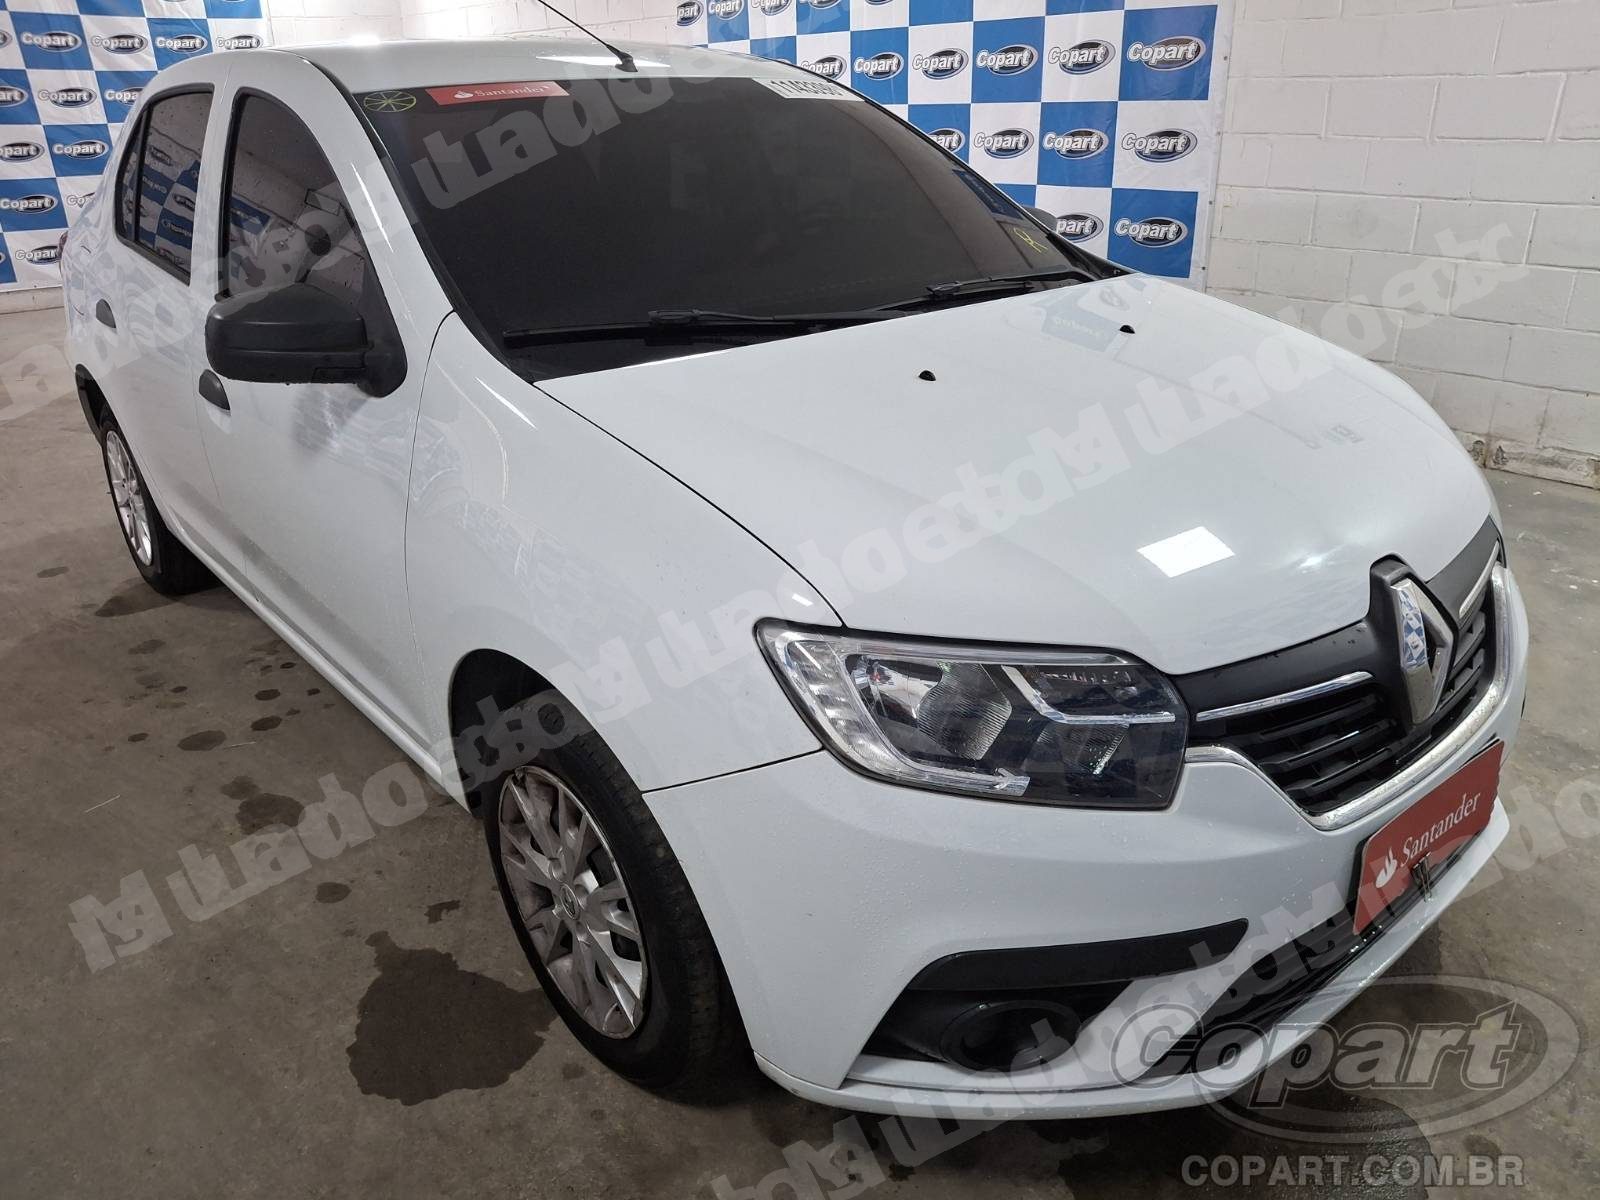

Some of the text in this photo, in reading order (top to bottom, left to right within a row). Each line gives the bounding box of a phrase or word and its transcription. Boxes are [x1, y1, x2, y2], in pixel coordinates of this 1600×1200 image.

[677, 5, 698, 20] part
[21, 31, 75, 48] Copart
[91, 35, 142, 49] Copart
[156, 36, 201, 51] Copart
[216, 37, 259, 50] Copart
[976, 48, 1032, 68] Copart
[1048, 43, 1105, 67] Copart
[1128, 40, 1199, 63] Copart
[855, 54, 898, 75] Copart
[912, 53, 962, 74] Copart
[38, 89, 88, 105] Copart
[104, 89, 137, 102] Copa
[474, 85, 550, 97] Santander
[53, 143, 102, 157] Copart
[973, 132, 1027, 151] Copart
[1043, 132, 1104, 152] Copart
[1122, 133, 1188, 153] Copart
[0, 197, 51, 212] Copart
[1056, 217, 1095, 234] part
[1116, 218, 1178, 241] Copart
[15, 249, 58, 262] Copar
[1401, 792, 1481, 866] Santander
